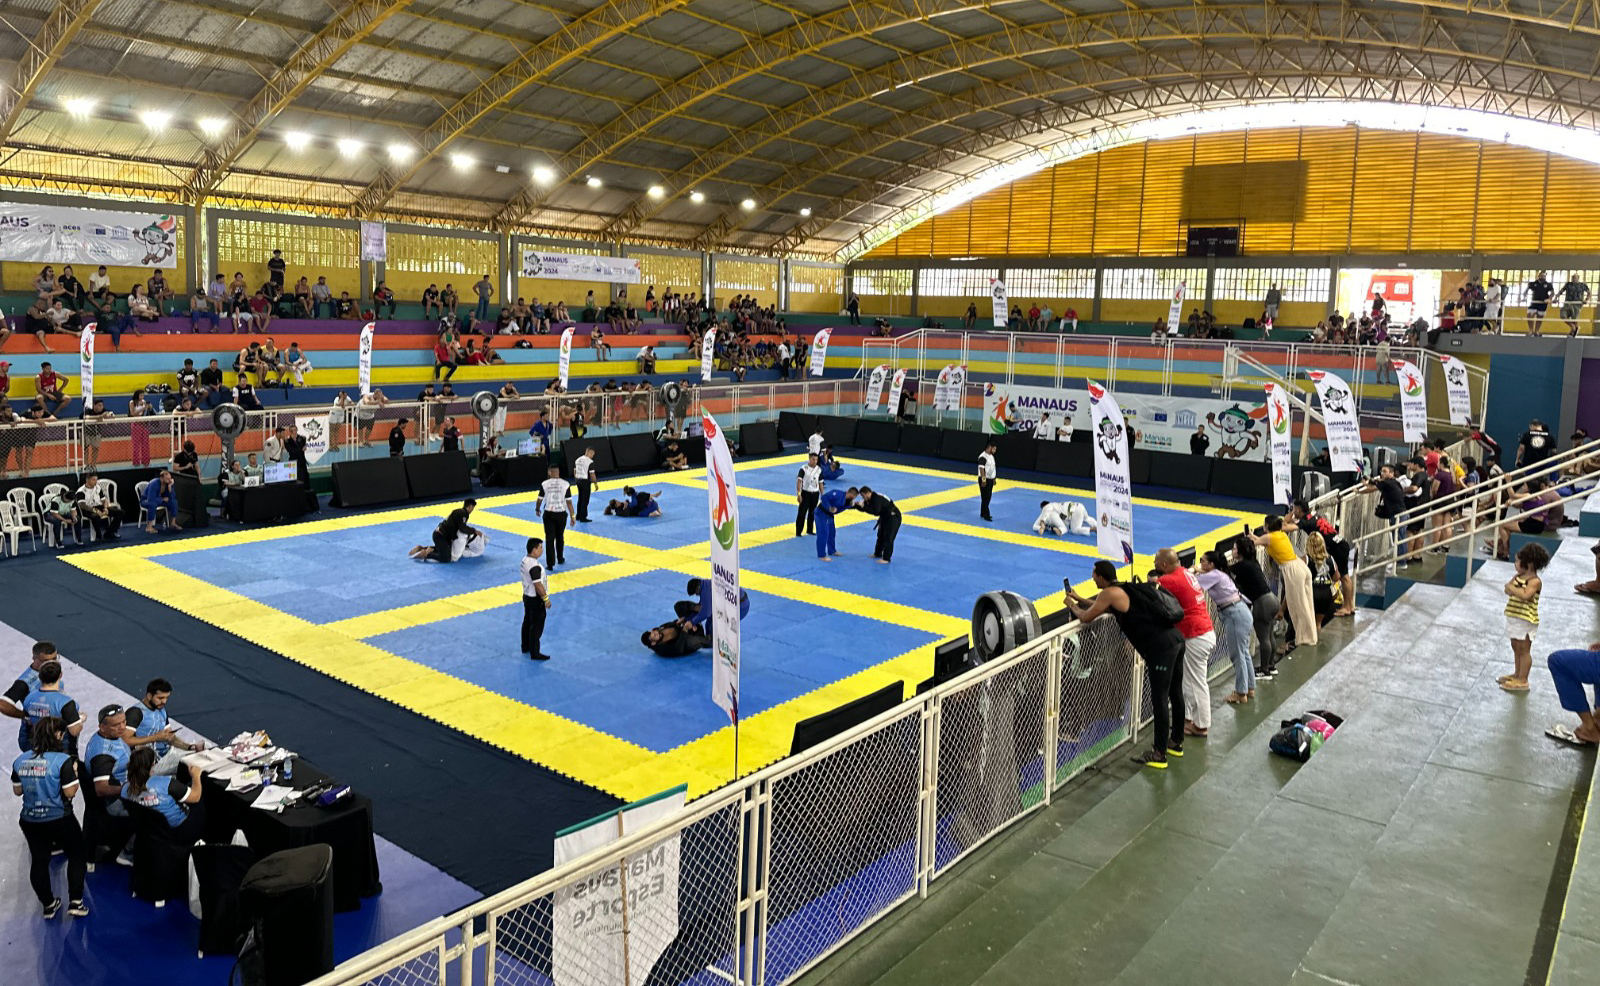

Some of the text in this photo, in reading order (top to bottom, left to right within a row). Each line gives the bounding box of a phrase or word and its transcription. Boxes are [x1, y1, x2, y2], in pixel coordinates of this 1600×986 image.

[0, 215, 29, 227] AUS
[1018, 396, 1077, 411] MANAUS
[1019, 419, 1039, 430] 20
[1113, 485, 1129, 496] 2024
